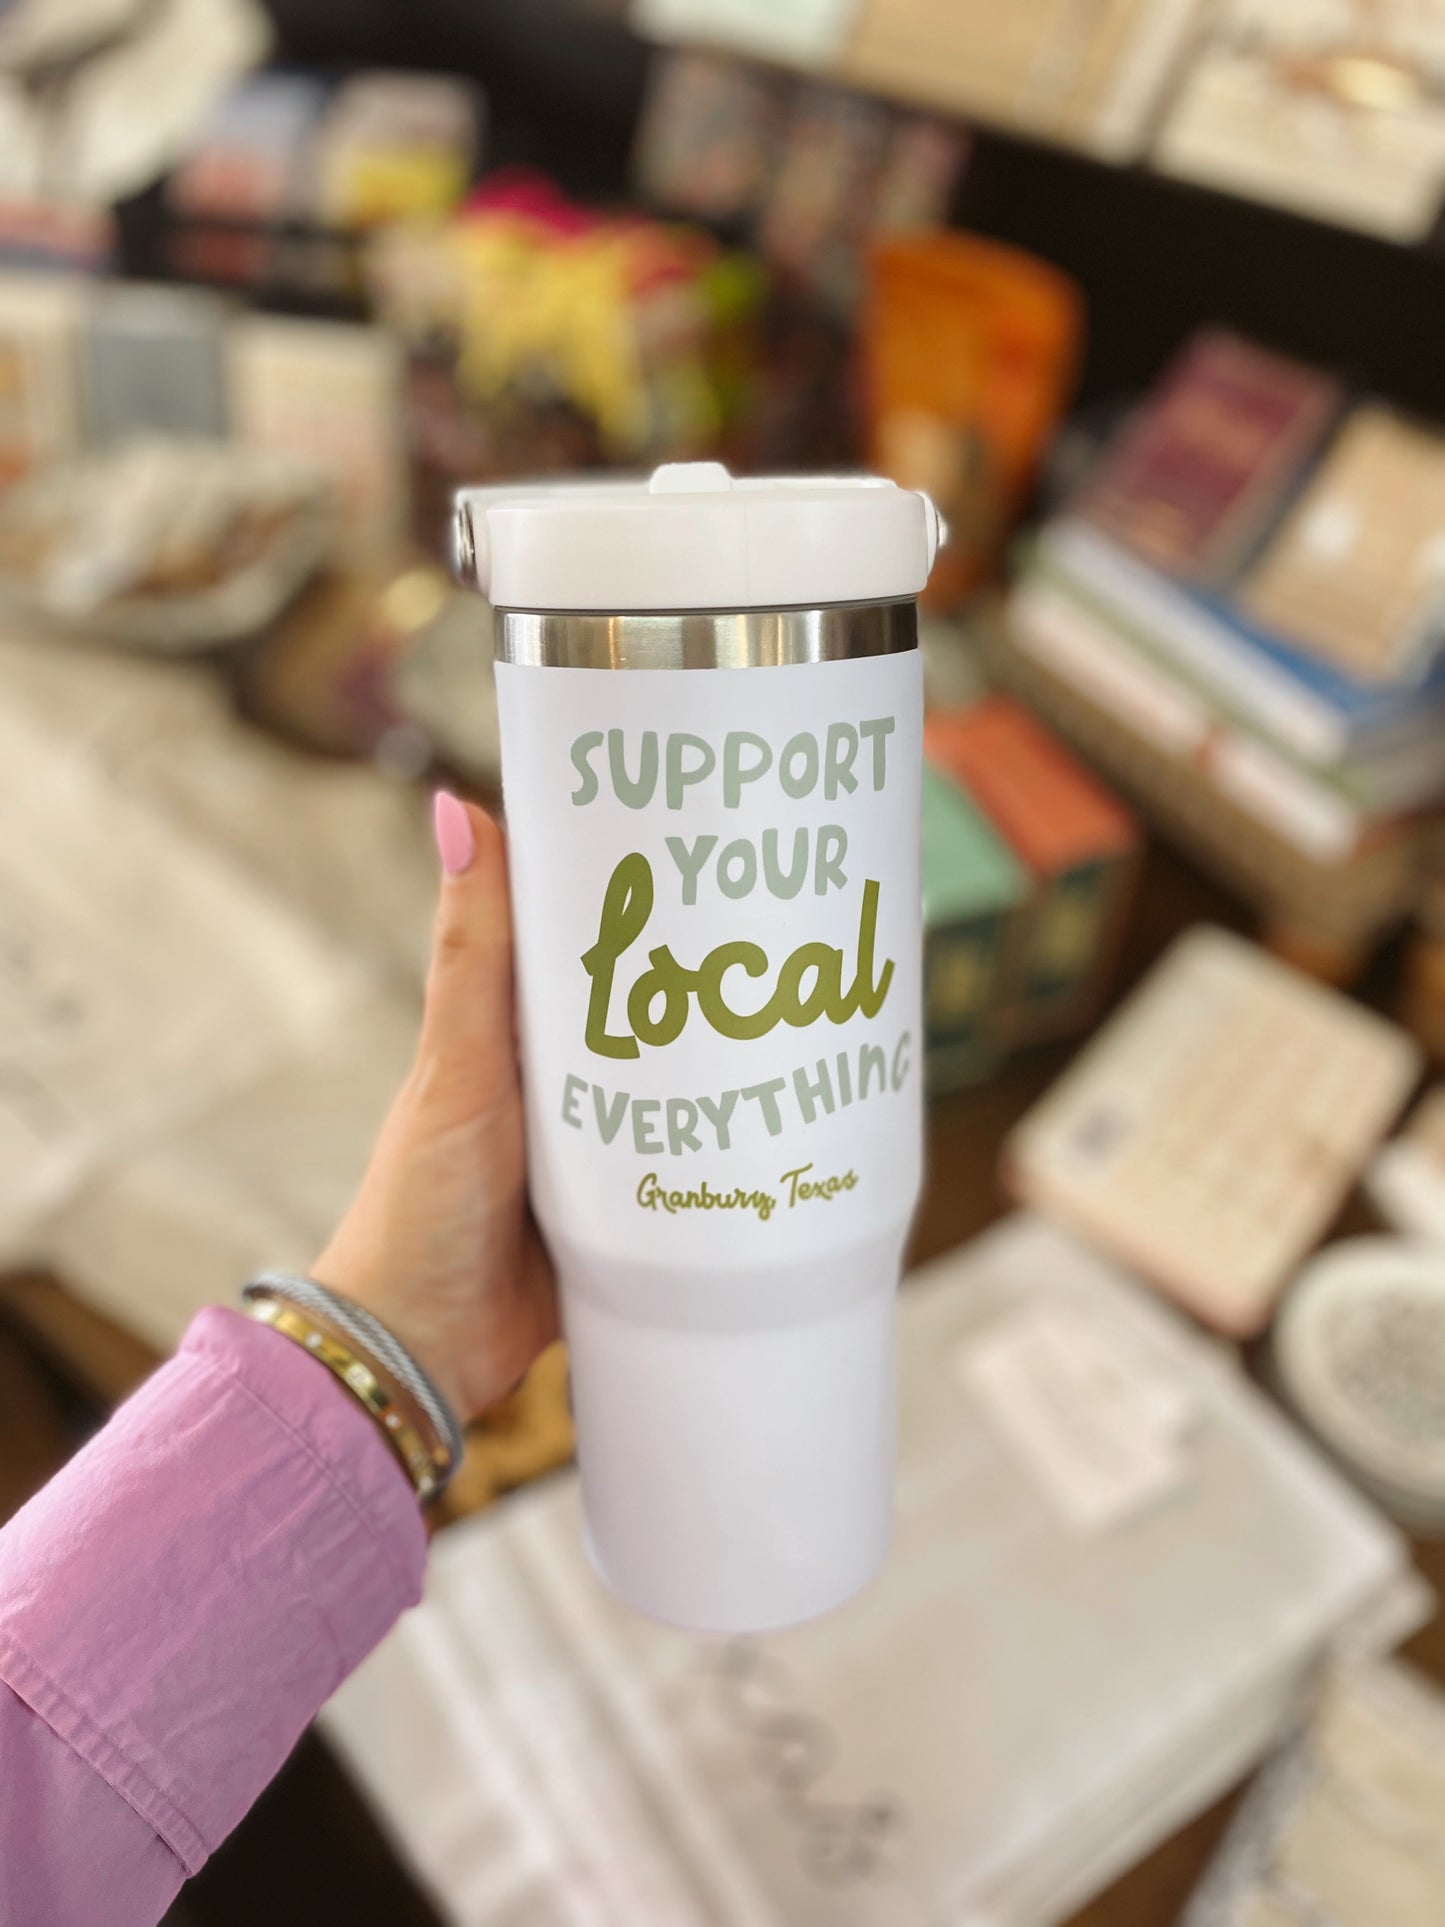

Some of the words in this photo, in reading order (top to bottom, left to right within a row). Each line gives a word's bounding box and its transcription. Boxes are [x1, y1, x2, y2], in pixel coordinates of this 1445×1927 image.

[570, 716, 895, 810] SUPPORT
[664, 824, 849, 906] YOUR
[636, 1173, 776, 1221] Granbury,
[780, 1162, 859, 1208] Texas
